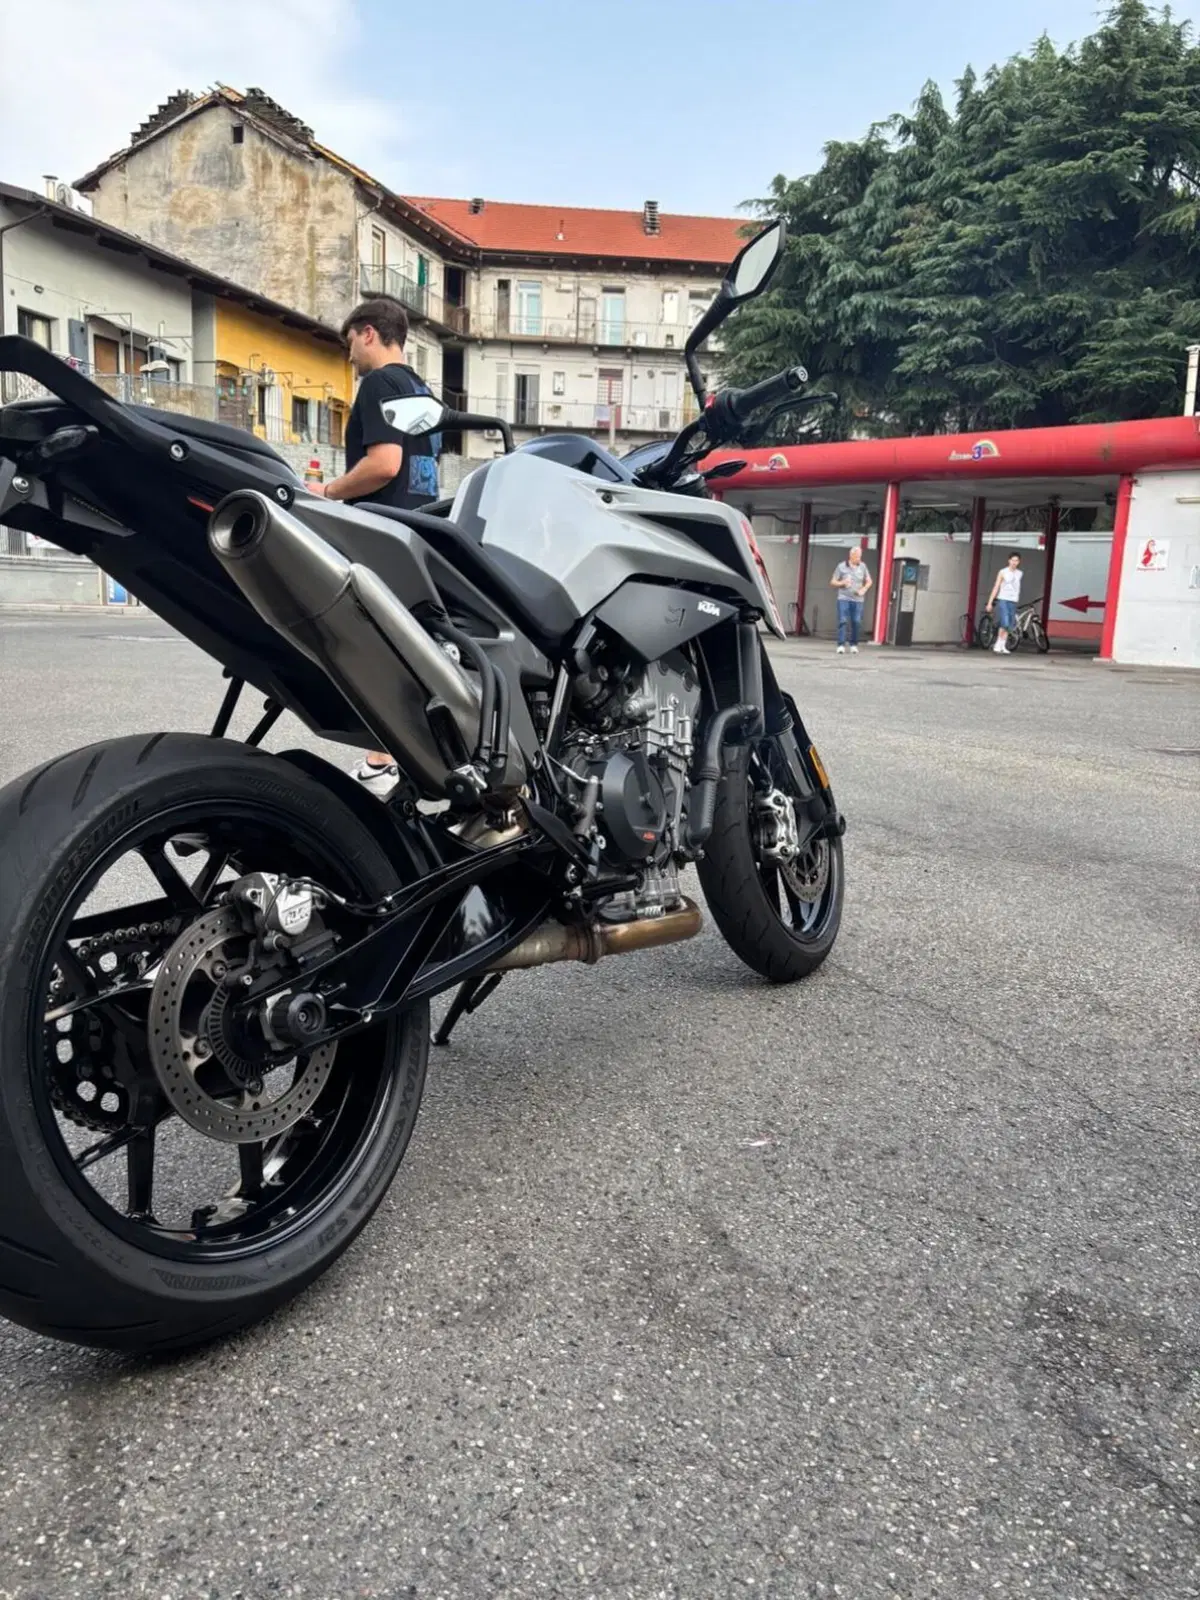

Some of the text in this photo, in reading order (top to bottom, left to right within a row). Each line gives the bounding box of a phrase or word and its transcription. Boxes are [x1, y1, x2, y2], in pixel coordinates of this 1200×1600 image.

[972, 445, 983, 461] 3
[768, 458, 778, 471] 2
[697, 600, 720, 616] KTM
